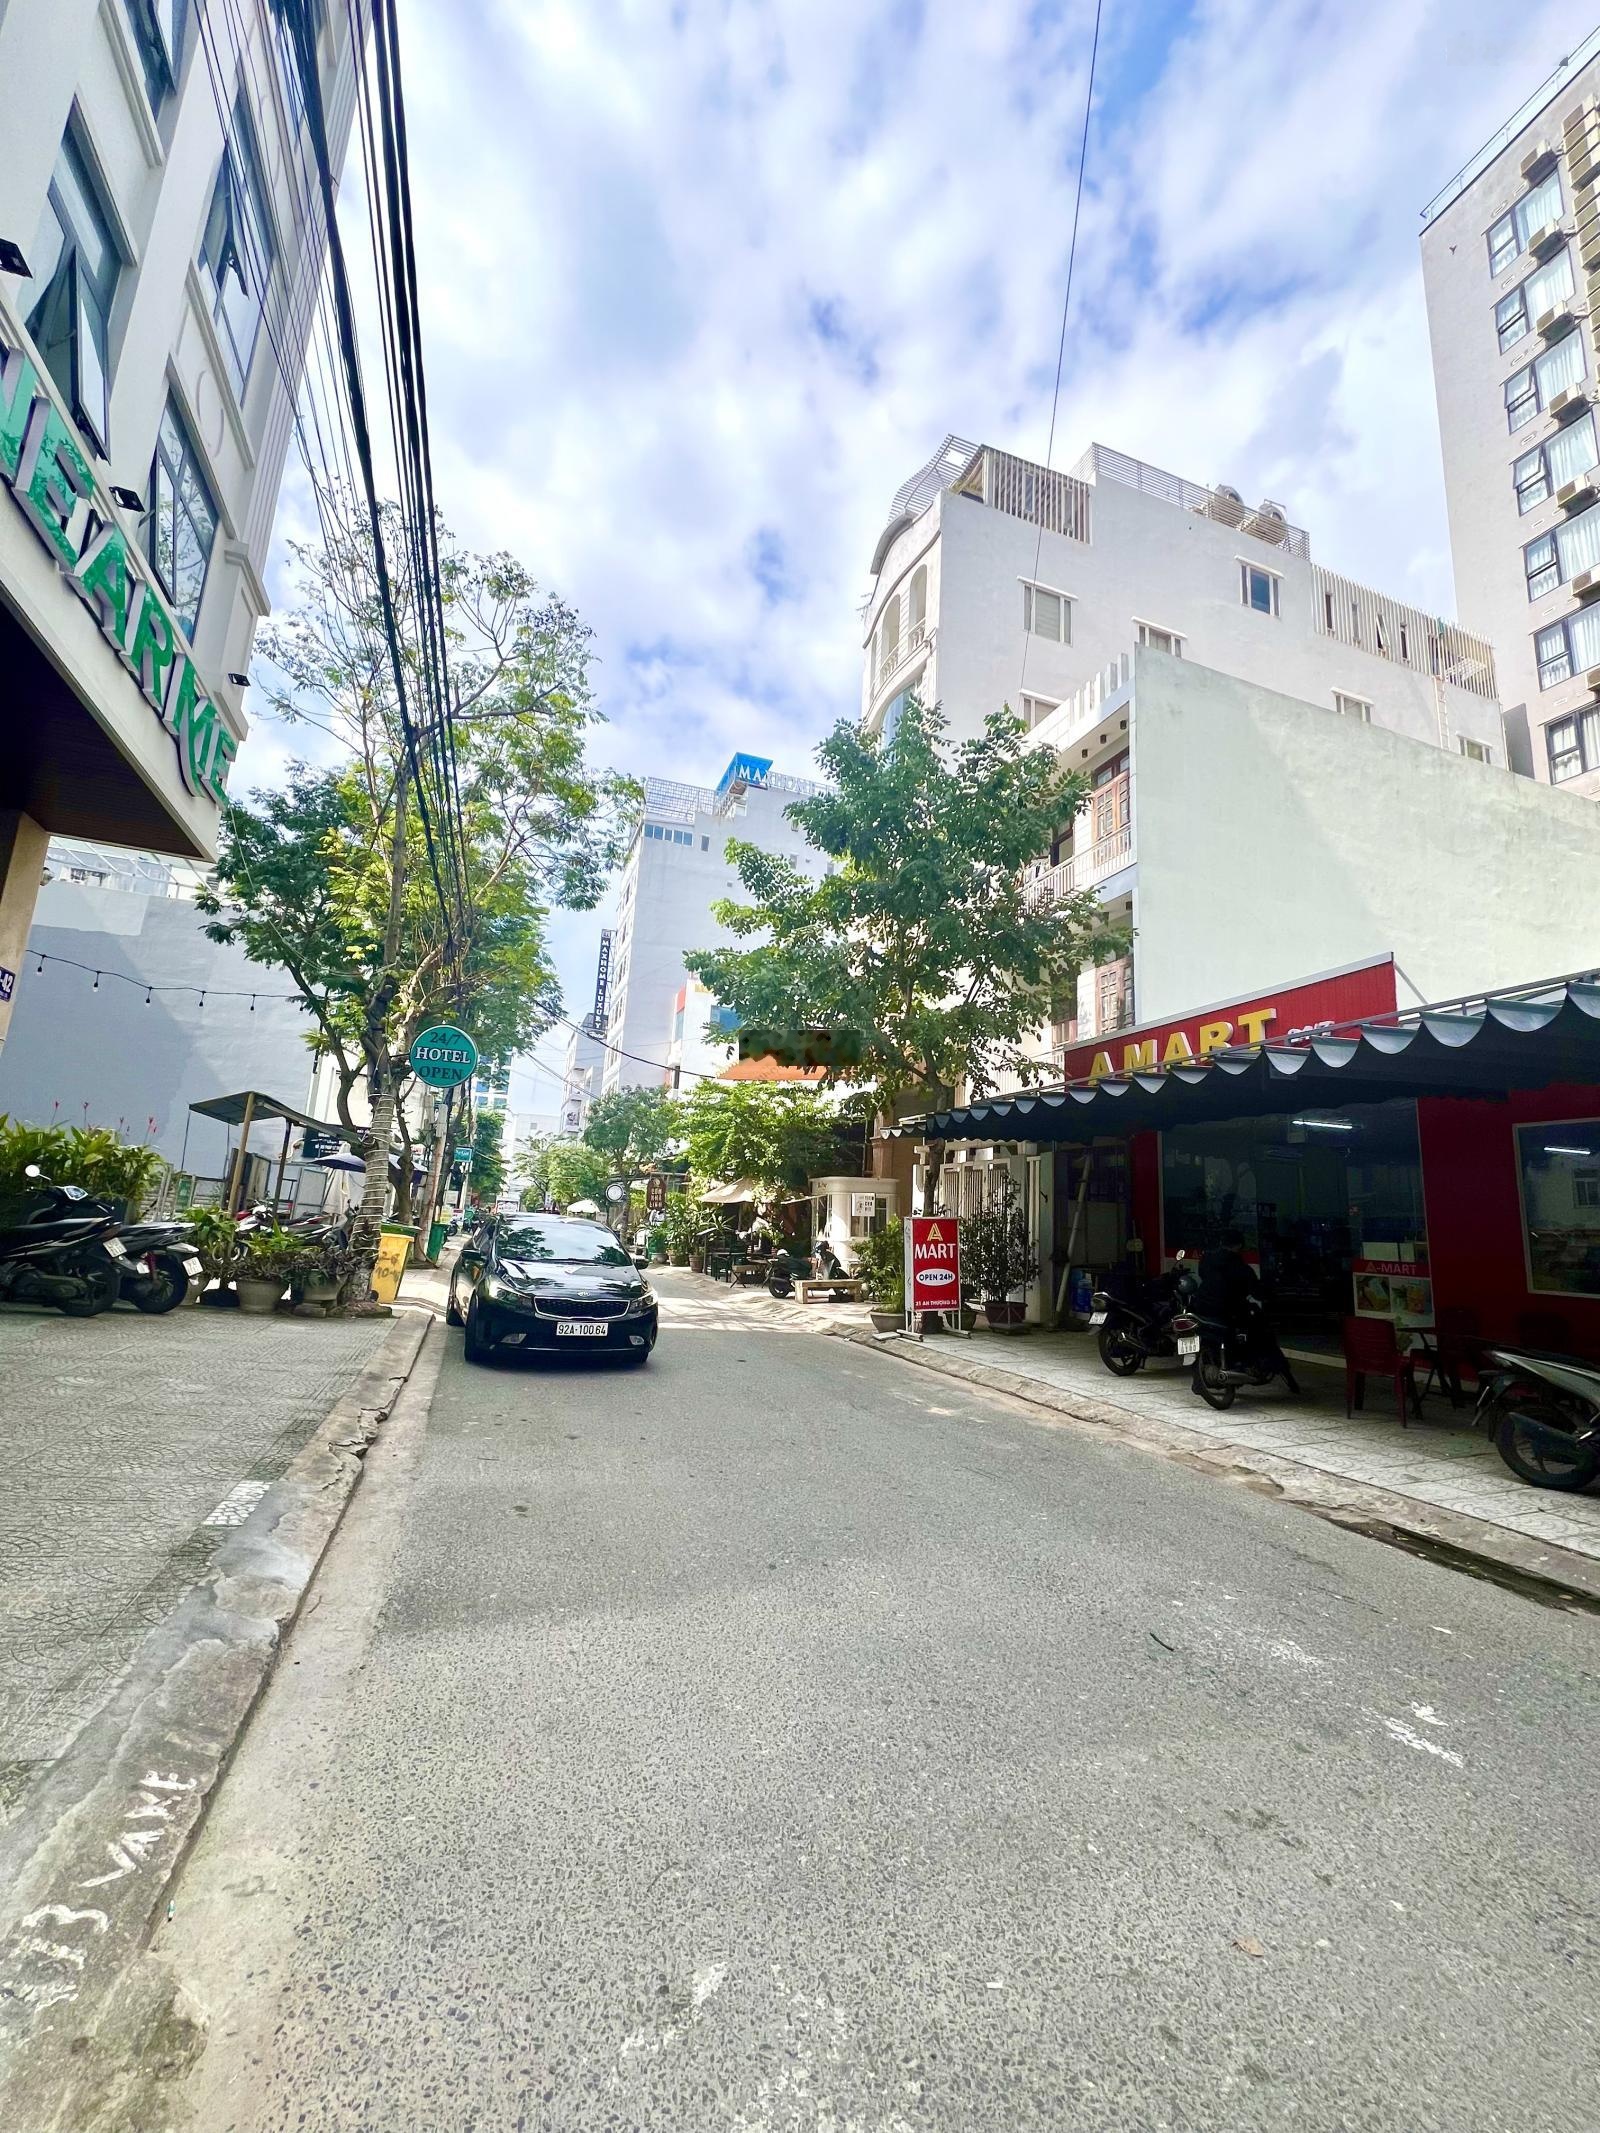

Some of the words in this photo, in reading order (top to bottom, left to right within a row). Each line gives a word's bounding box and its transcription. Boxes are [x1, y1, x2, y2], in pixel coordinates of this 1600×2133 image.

[0, 970, 13, 993] -42
[595, 988, 605, 1029] LUXURY
[430, 1032, 462, 1046] 24/7
[1088, 1051, 1114, 1085] A
[1124, 1008, 1276, 1074] MART
[415, 1046, 471, 1064] HOTEL
[418, 1065, 463, 1081] OPEN
[927, 1222, 944, 1242] A
[914, 1243, 957, 1260] MART
[918, 1272, 938, 1282] OPEN
[939, 1272, 954, 1282] 24H
